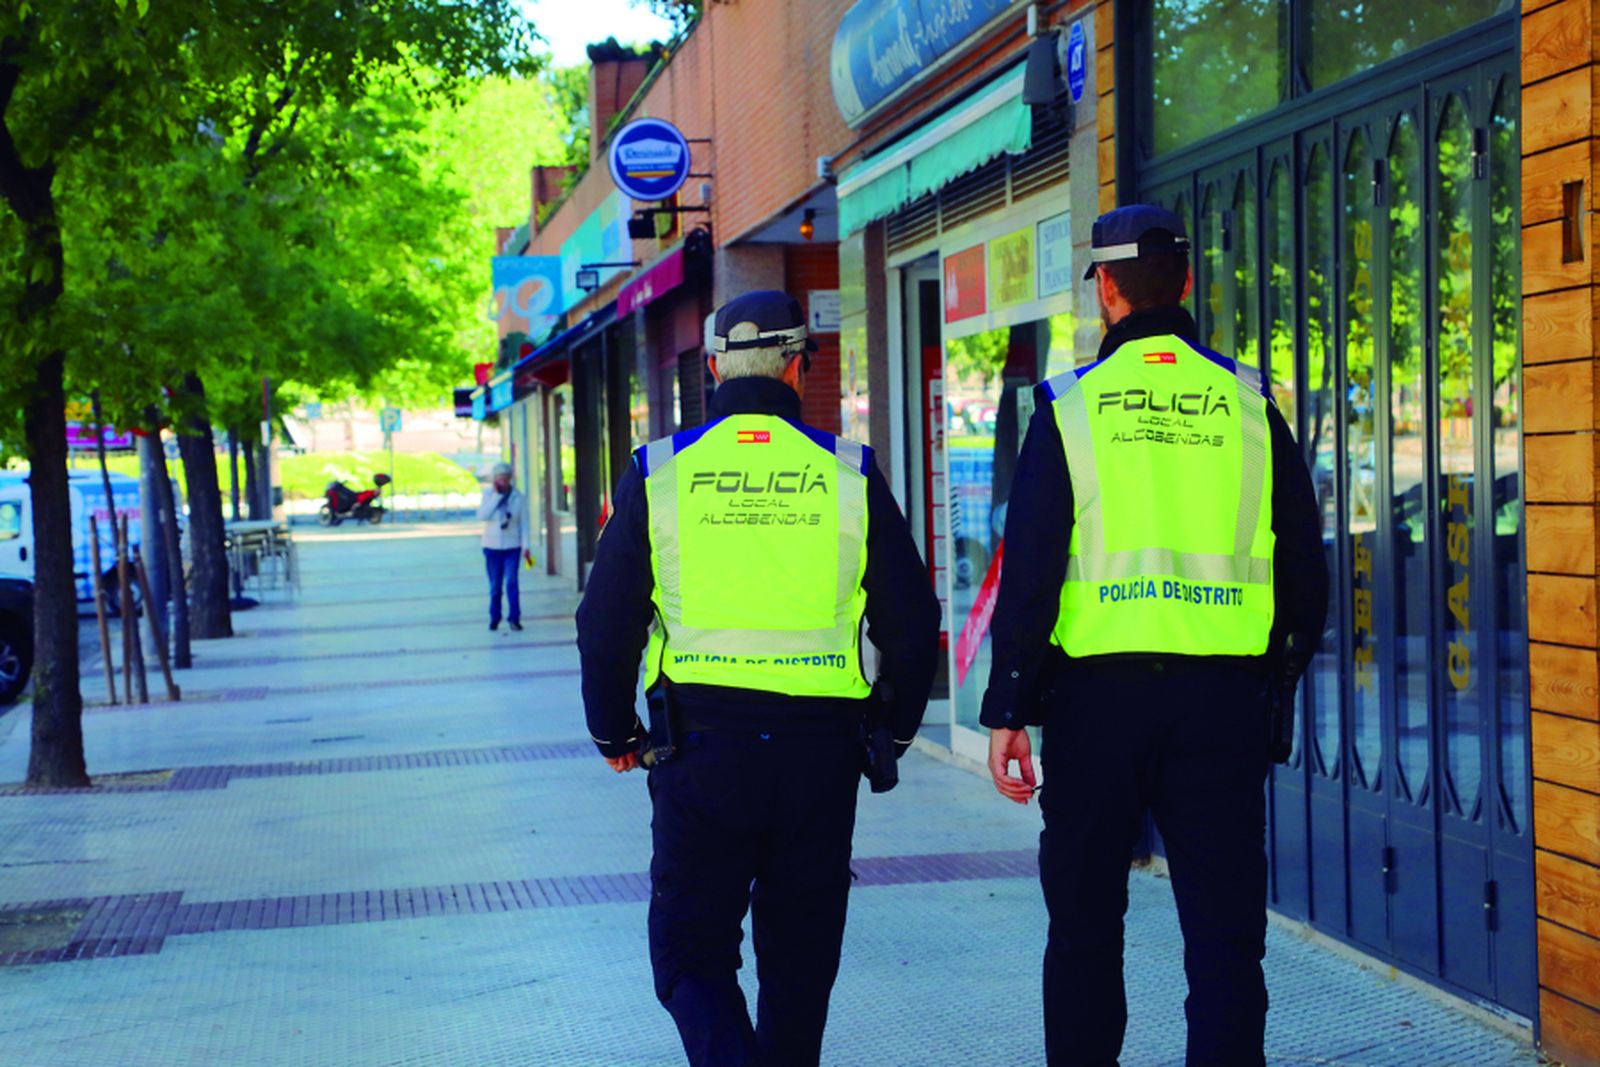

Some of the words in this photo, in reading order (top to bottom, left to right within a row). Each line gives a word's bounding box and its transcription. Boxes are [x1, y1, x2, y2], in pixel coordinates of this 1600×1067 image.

[1098, 386, 1231, 416] POLICÍA
[1137, 415, 1194, 428] LOCAL
[1110, 428, 1225, 447] ALCOBENDAS
[689, 464, 828, 494] POLICÍA
[728, 499, 790, 508] LOCAL
[698, 513, 821, 526] ALCOBENDAS
[1099, 576, 1157, 603] POLICÍA
[1163, 580, 1182, 600] DE
[1182, 583, 1244, 607] DISTRITO
